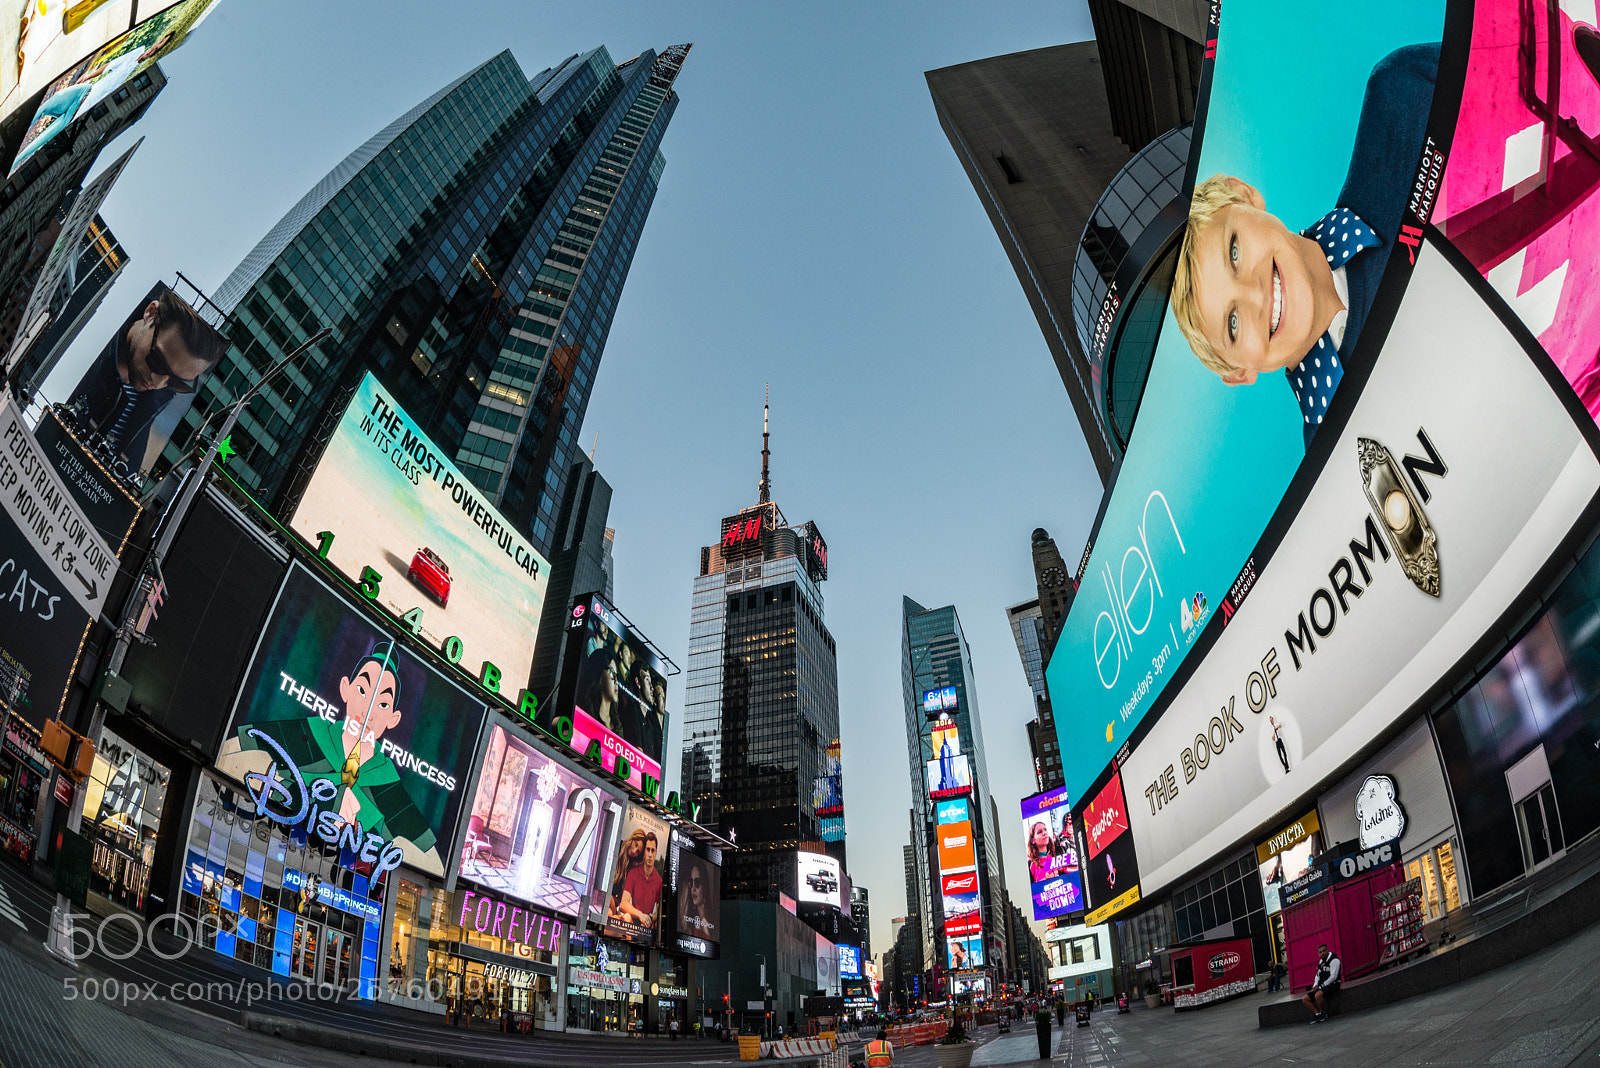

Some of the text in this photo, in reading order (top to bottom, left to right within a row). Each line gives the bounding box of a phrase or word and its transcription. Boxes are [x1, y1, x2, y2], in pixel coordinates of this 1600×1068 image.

[1410, 136, 1435, 213] MARRIOTT
[1418, 154, 1443, 221] MARQUIS
[1093, 281, 1117, 352] MARRIOTT
[1098, 299, 1119, 361] MARQUIS
[359, 414, 423, 487] IN ITS CLASS
[55, 440, 115, 504] LET THE MEMORY
[59, 460, 101, 504] LIVE AGAIN
[370, 393, 540, 581] THE MOST POWERFUL CAR
[0, 451, 54, 546] EEP MOVING
[4, 420, 111, 580] PEDESTRIAN FLOW ZONE
[724, 517, 762, 546] H&M
[813, 536, 828, 569] H&M
[1094, 490, 1185, 689] ellen
[1231, 557, 1255, 597] MARRIOTT
[1234, 571, 1256, 606] MARQUIS
[571, 618, 583, 628] LG
[600, 610, 609, 622] LG
[1180, 597, 1195, 634] 4
[1185, 606, 1211, 646] NEW YORK
[928, 689, 951, 702] 6:41
[1119, 644, 1171, 723] Weekdays 3pm
[279, 671, 458, 793] THERE IS A PRINCESS
[931, 723, 957, 733] TOSHIBA
[934, 719, 953, 728] 2016
[1145, 764, 1179, 816] THE
[1181, 695, 1245, 784] BOOK
[1246, 647, 1282, 713] OF
[6, 740, 28, 760] SONY
[604, 734, 646, 770] LG OLED TV
[930, 785, 971, 799] TOSHIBA
[944, 807, 967, 818] TDK
[1092, 807, 1116, 842] swatch
[554, 788, 622, 893] 21
[1268, 821, 1306, 855] INVICTA
[1050, 856, 1068, 870] ARE
[1355, 844, 1393, 872] NYC
[1284, 869, 1323, 895] The Official Guide
[1286, 888, 1310, 904] nycgo.com
[1048, 892, 1076, 911] DOWN
[459, 889, 562, 953] FOREVER
[483, 962, 538, 987] FOREVER 21
[577, 969, 589, 981] U.S.
[589, 971, 608, 984] POLO
[1209, 955, 1240, 970] STRAND
[659, 985, 688, 998] sunglass hut
